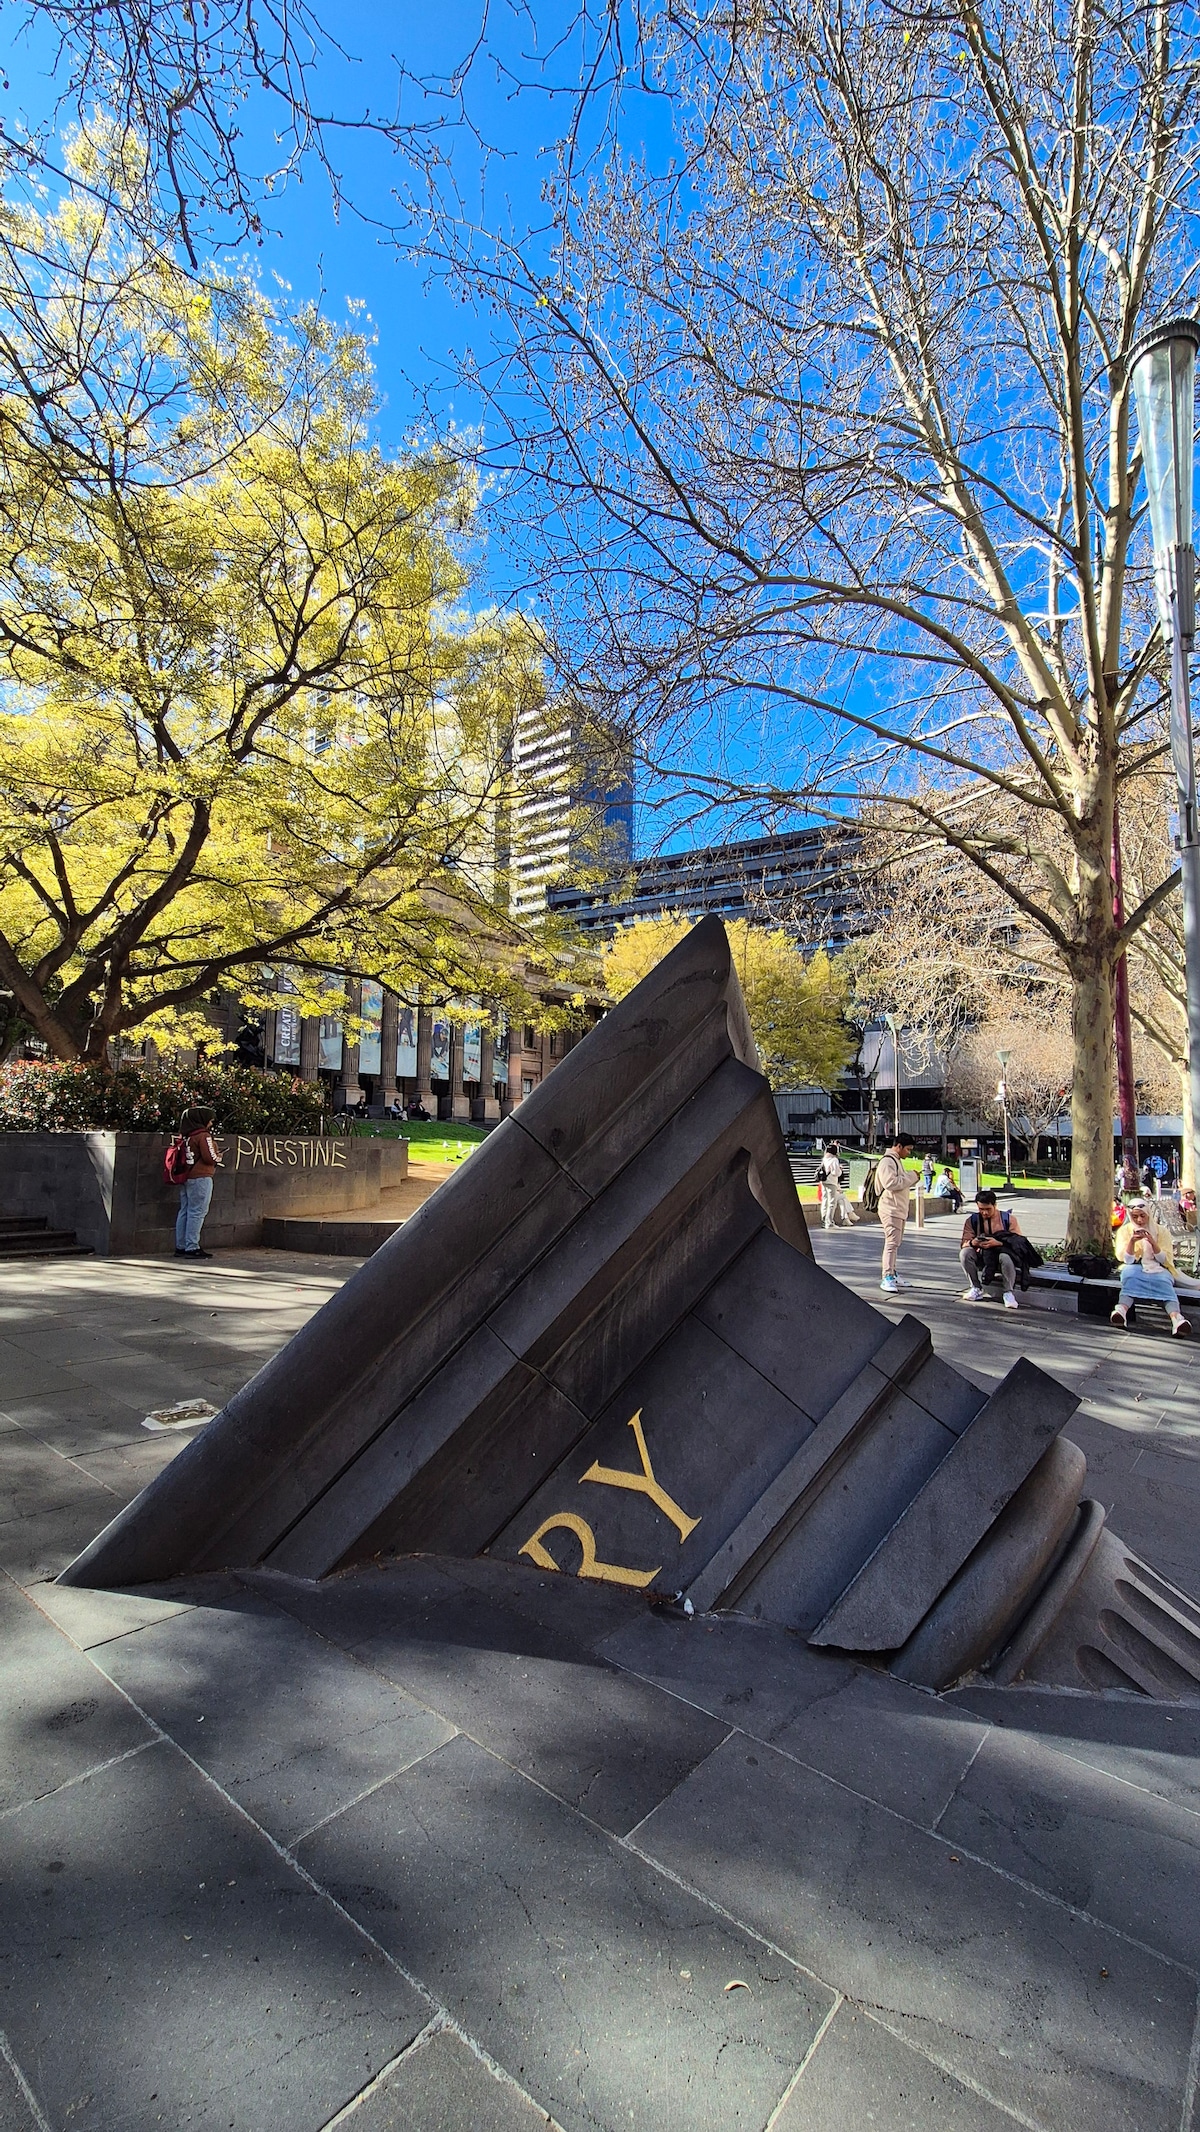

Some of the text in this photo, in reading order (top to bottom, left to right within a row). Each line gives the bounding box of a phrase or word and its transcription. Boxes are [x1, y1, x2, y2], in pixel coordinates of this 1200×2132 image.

[281, 1000, 292, 1047] CREATI
[236, 1135, 347, 1170] PALESTINE
[518, 1407, 702, 1588] RY
